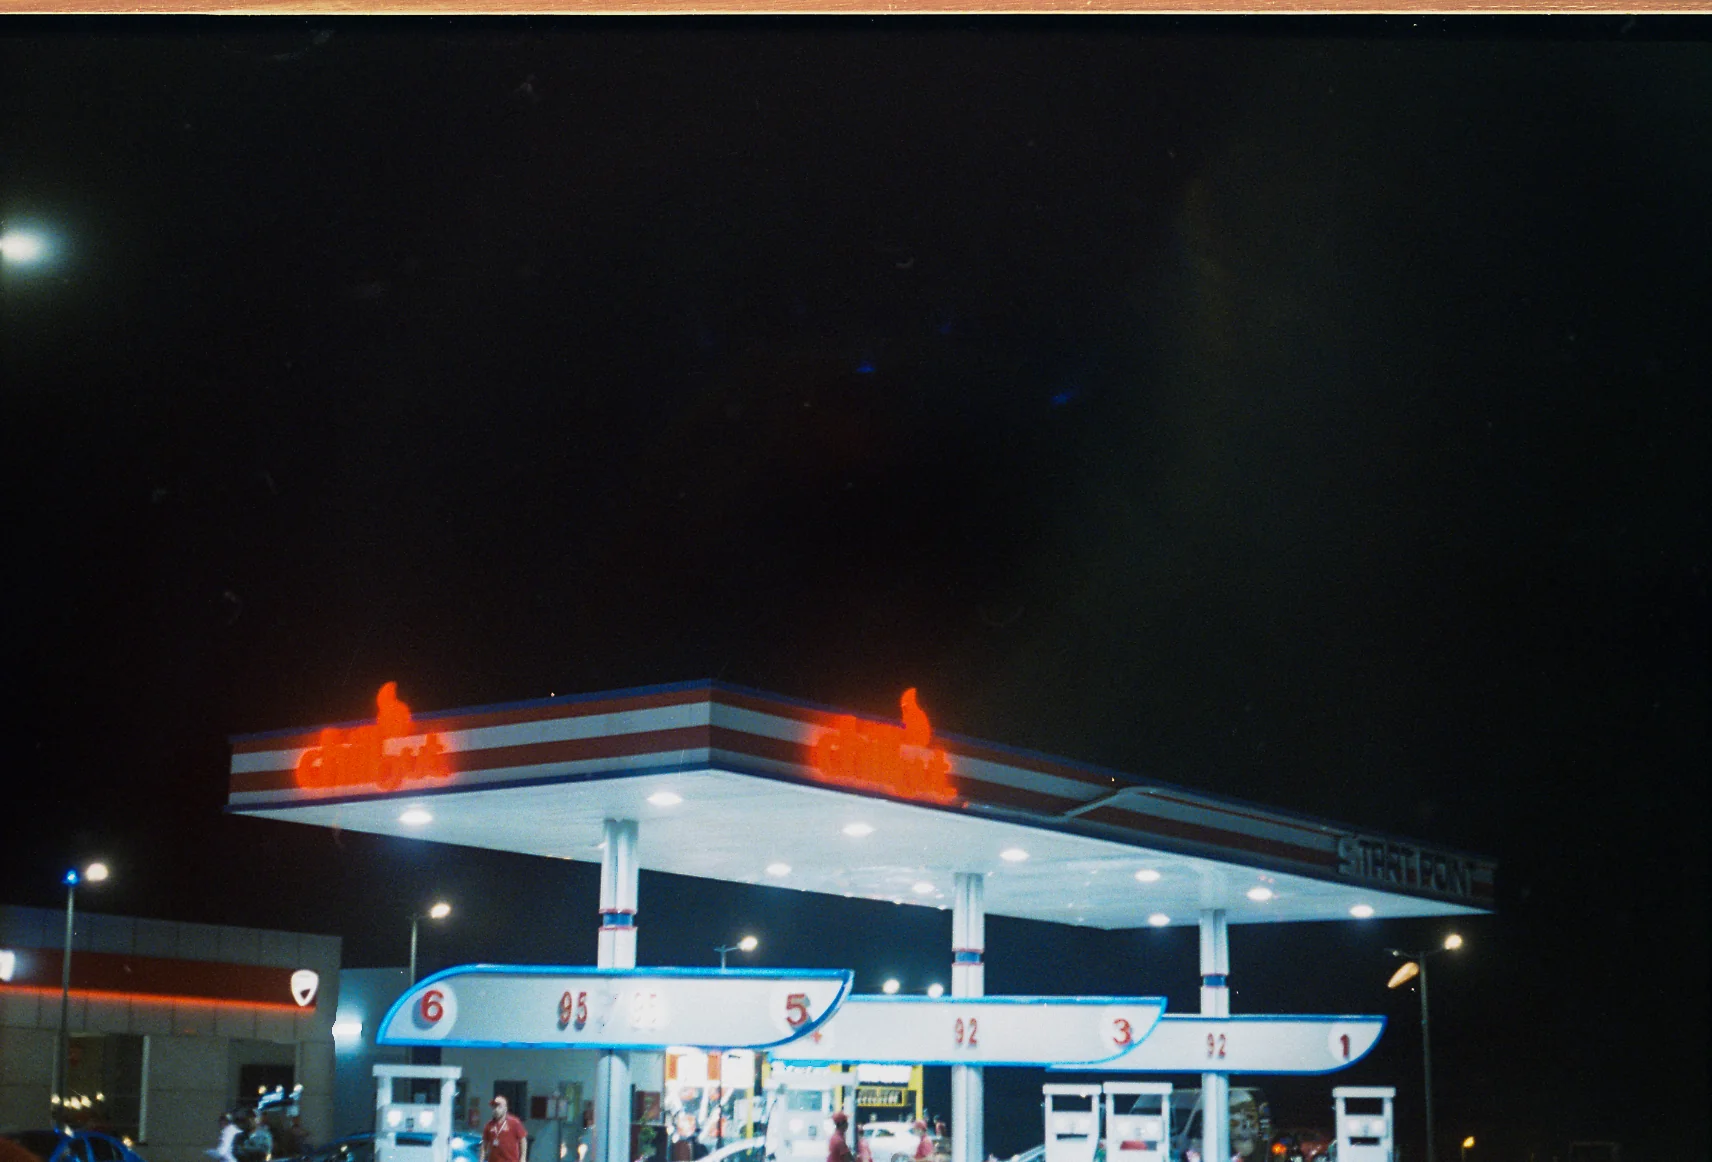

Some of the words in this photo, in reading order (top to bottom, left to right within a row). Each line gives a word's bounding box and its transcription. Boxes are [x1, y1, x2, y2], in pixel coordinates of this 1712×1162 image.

[419, 989, 445, 1023] 6
[559, 990, 588, 1025] 95
[785, 993, 809, 1026] 5
[954, 1017, 978, 1045] 92
[1112, 1018, 1133, 1046] 3
[1206, 1032, 1227, 1058] 92
[1339, 1034, 1351, 1058] 1
